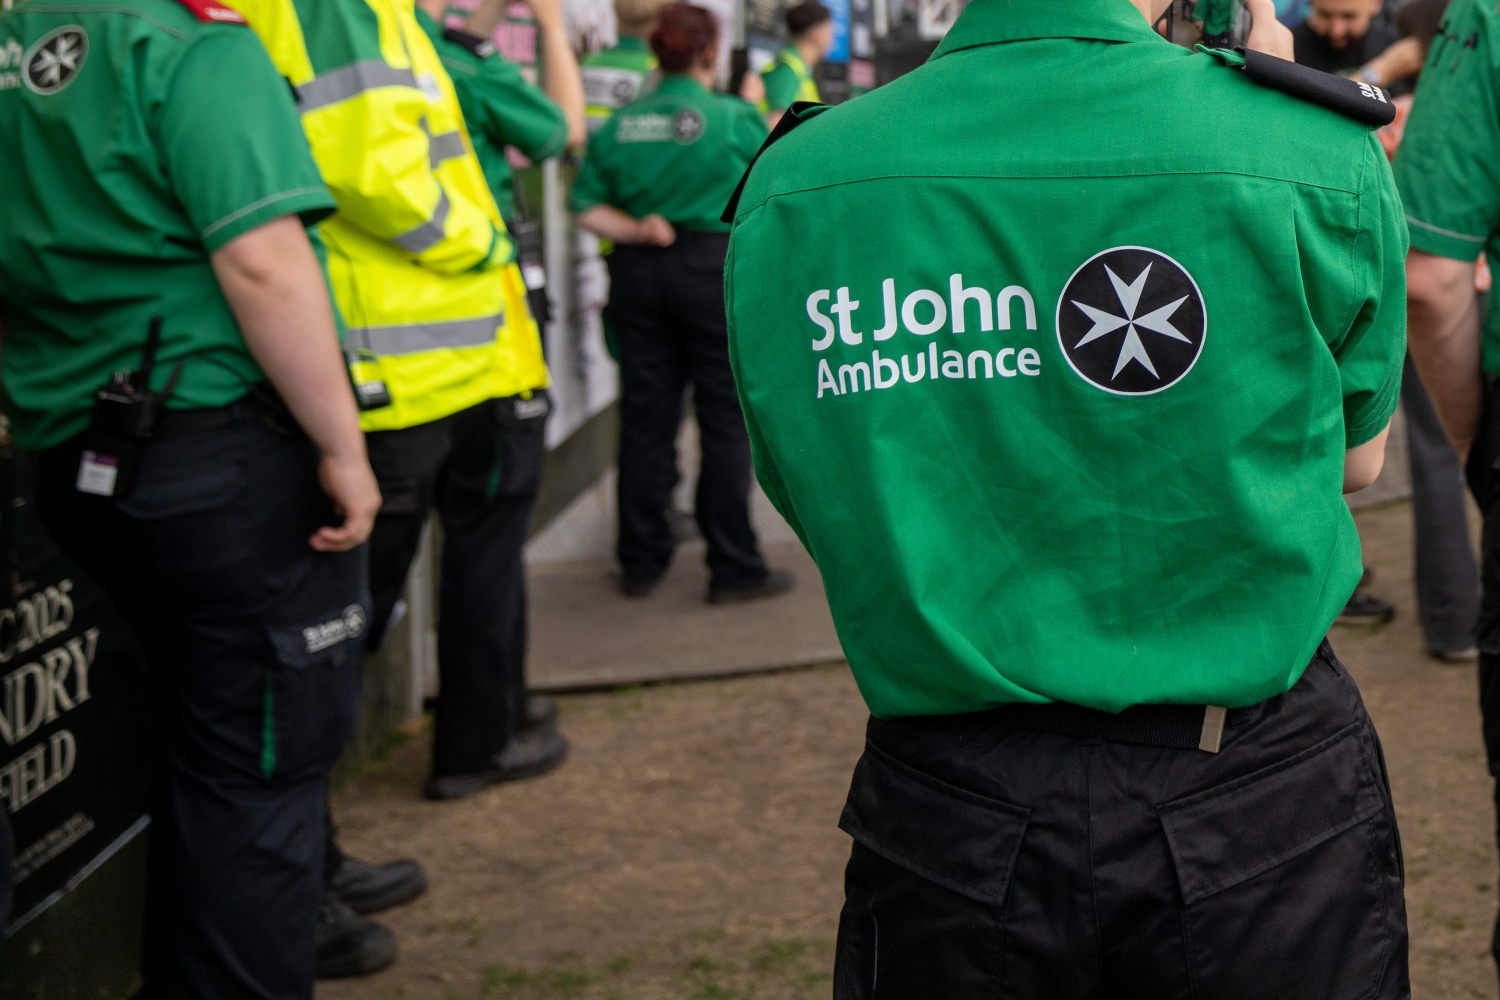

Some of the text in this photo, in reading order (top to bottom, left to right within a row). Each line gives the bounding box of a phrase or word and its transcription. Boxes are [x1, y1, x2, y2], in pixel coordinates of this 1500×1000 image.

[806, 274, 1037, 351] St John
[817, 342, 1042, 399] Ambulance
[15, 578, 74, 653] 2025
